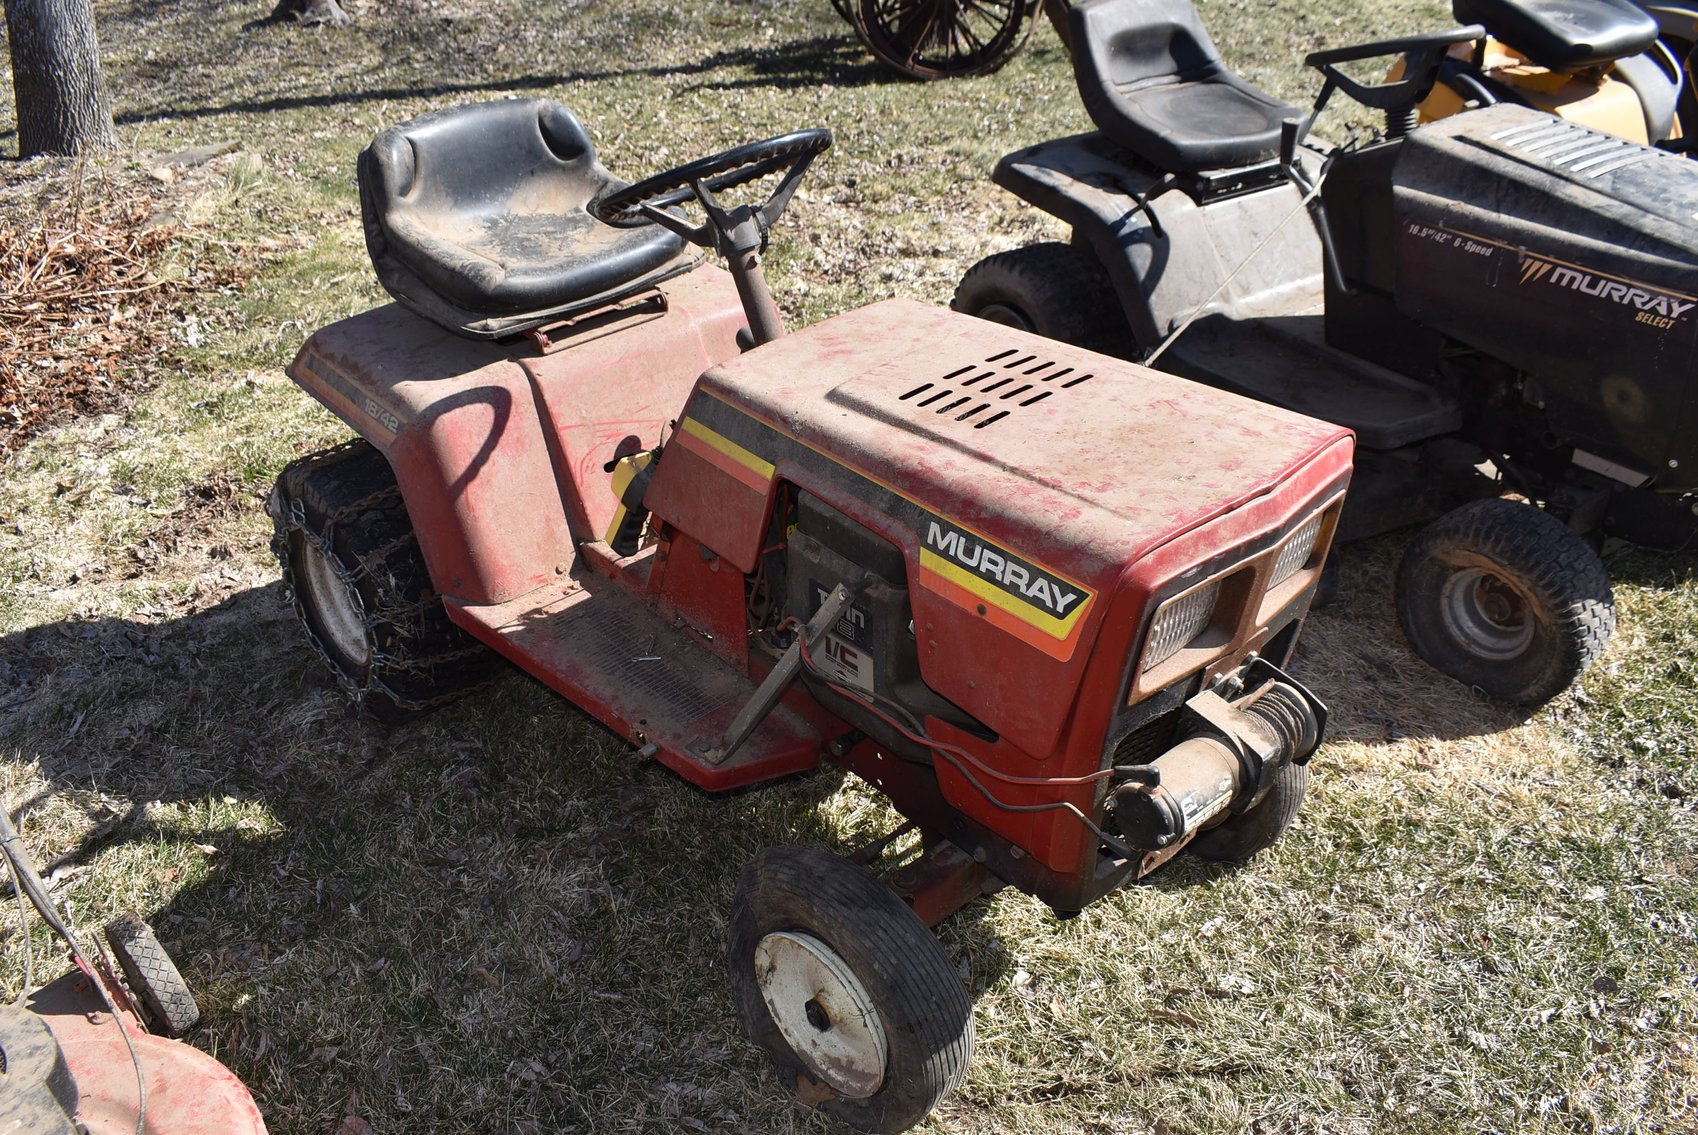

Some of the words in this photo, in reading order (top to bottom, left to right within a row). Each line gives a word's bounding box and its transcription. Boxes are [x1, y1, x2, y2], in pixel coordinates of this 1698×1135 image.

[1549, 267, 1696, 319] MURRAY
[1635, 311, 1676, 329] SELECT
[927, 521, 1078, 614] MURRAY
